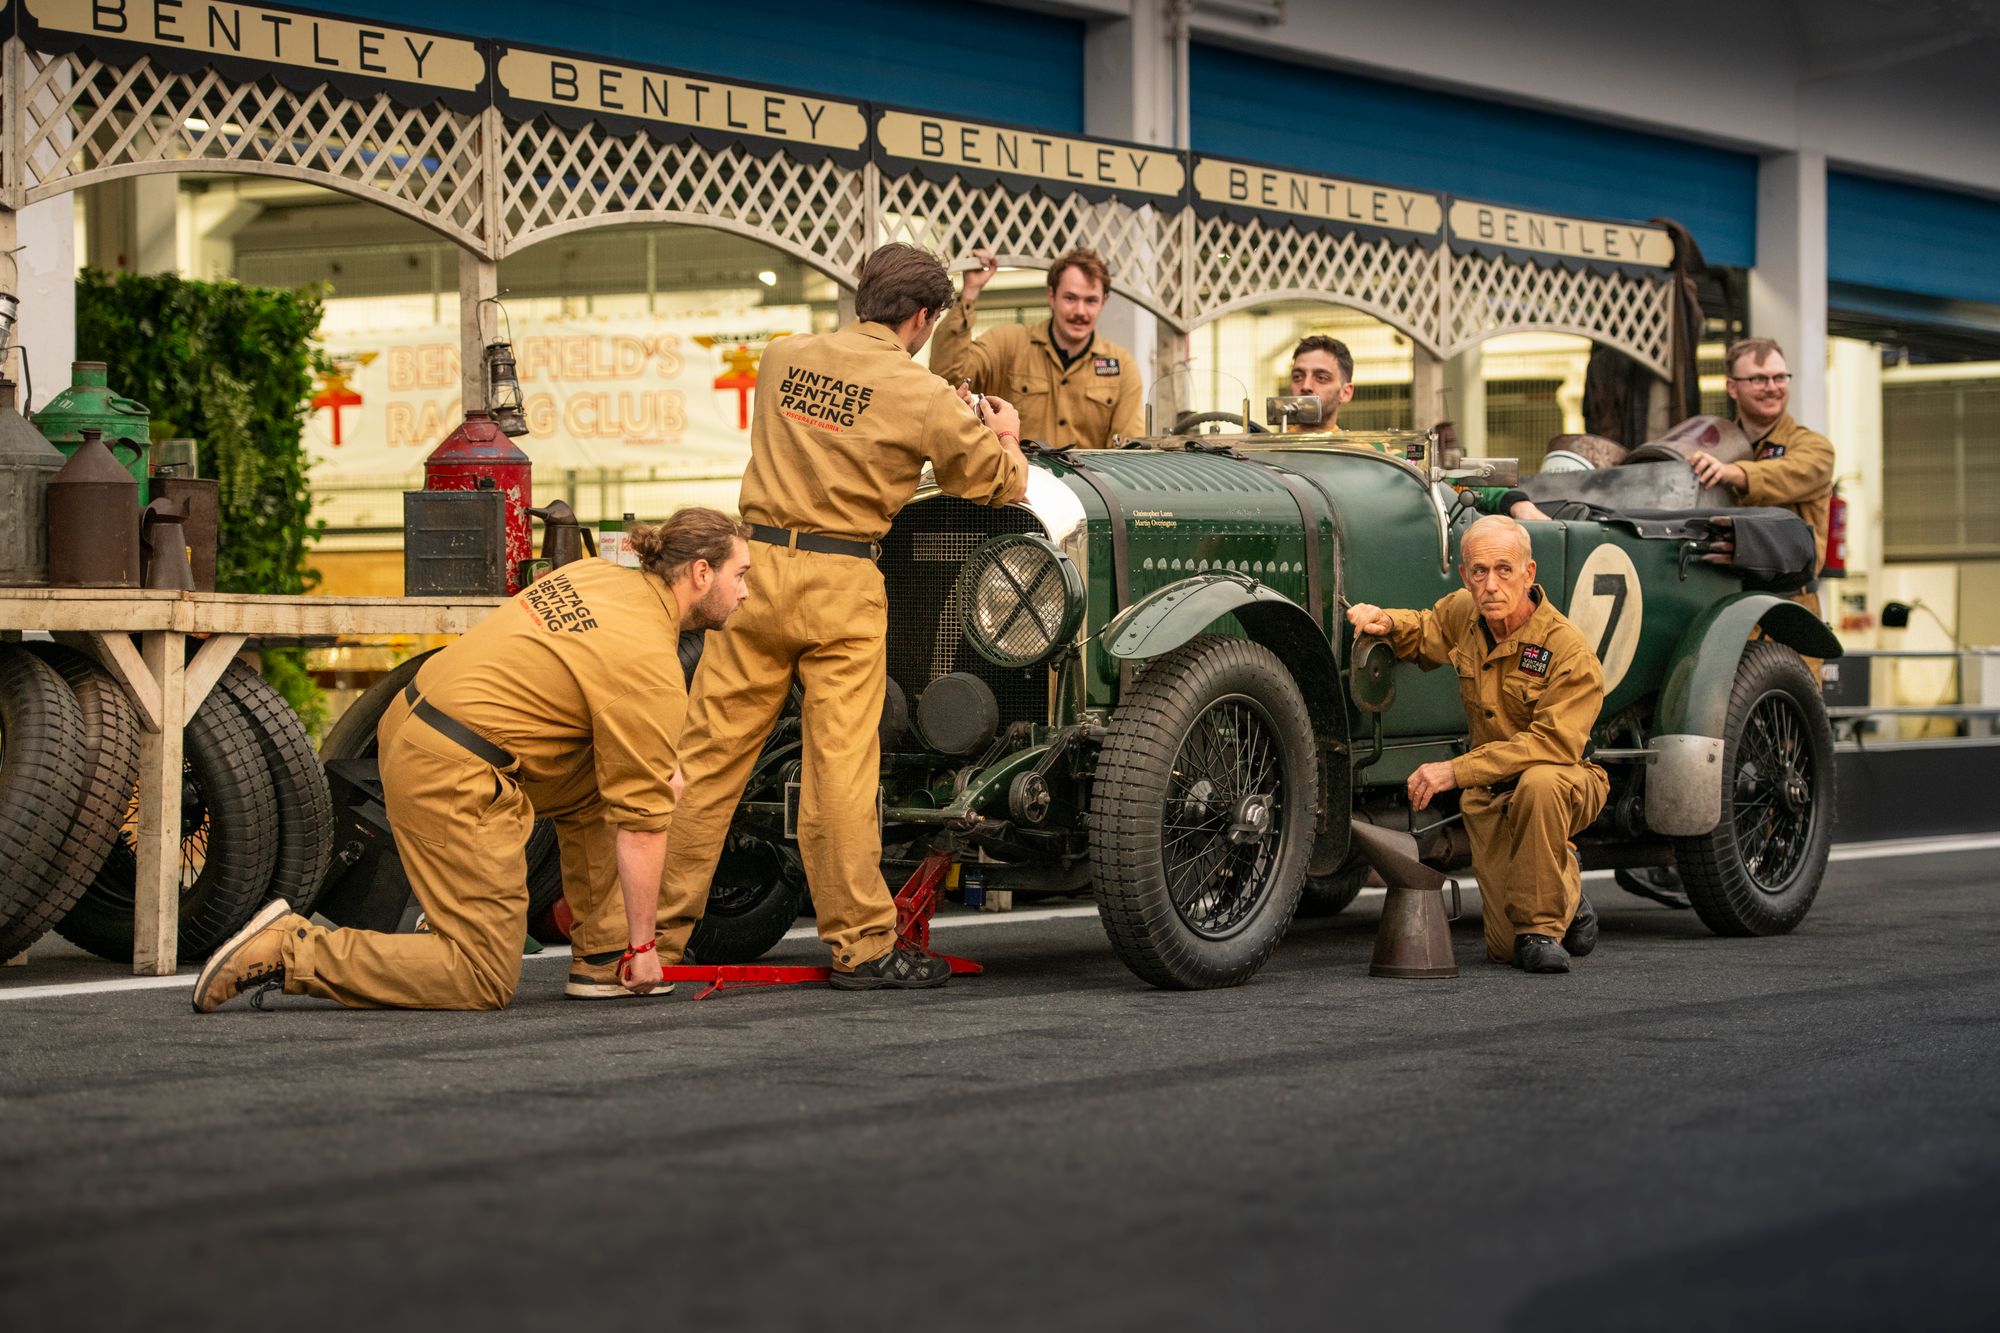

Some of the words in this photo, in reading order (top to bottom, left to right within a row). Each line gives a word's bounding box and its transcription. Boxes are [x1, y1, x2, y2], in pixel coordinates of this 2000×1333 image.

[92, 0, 434, 79] BENTLEY
[551, 61, 825, 139] BENTLEY
[921, 121, 1149, 187] BENTLEY
[1229, 168, 1415, 226] BENTLEY
[1478, 208, 1646, 259] BENTLEY
[387, 331, 685, 391] BENFIELD'S
[788, 366, 874, 402] VINTAGE
[564, 390, 688, 438] CLUB
[779, 379, 870, 415] BENTLEY
[780, 395, 855, 427] RACING
[525, 589, 563, 632] RACING
[538, 580, 584, 633] BENTLEY
[553, 573, 599, 631] VINTAGE
[1592, 573, 1628, 666] 7
[1541, 650, 1549, 662] 8
